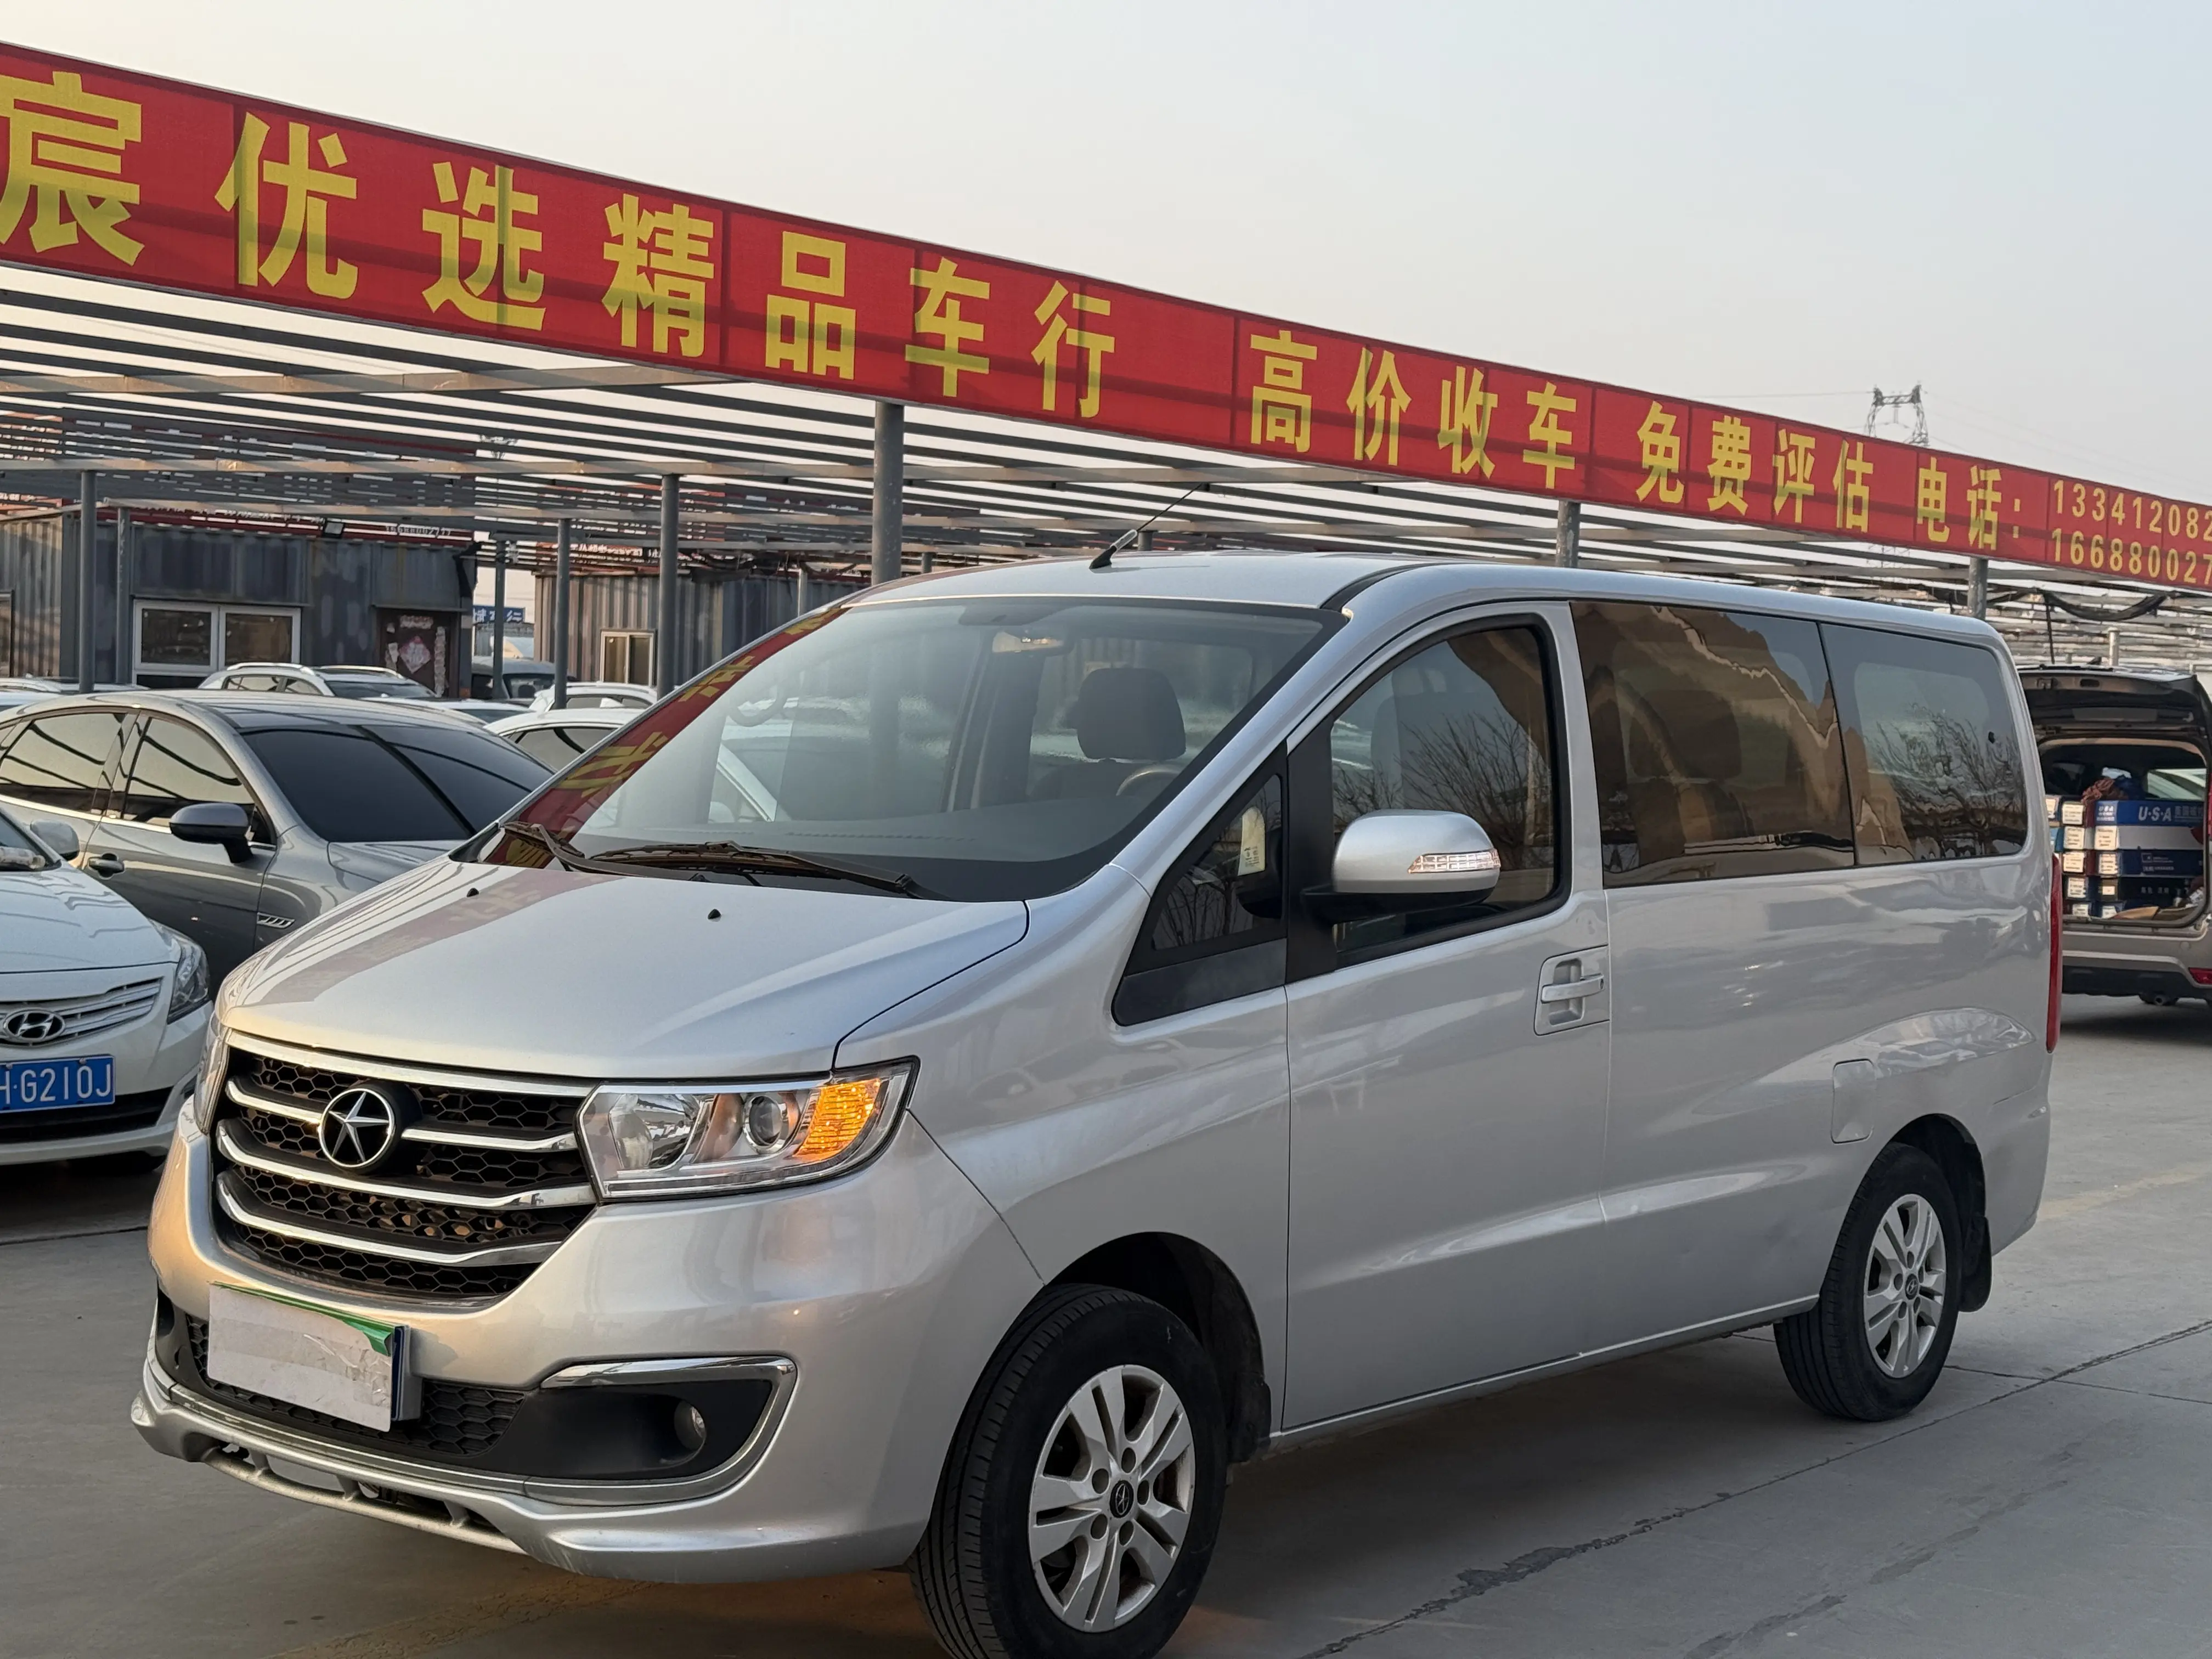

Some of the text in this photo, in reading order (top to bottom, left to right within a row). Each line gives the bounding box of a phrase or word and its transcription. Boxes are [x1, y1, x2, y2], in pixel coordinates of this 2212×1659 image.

[0, 71, 1115, 419] 宸优选精品车行
[1250, 330, 1577, 489] 高价收车
[1636, 400, 1874, 533] 免费评估
